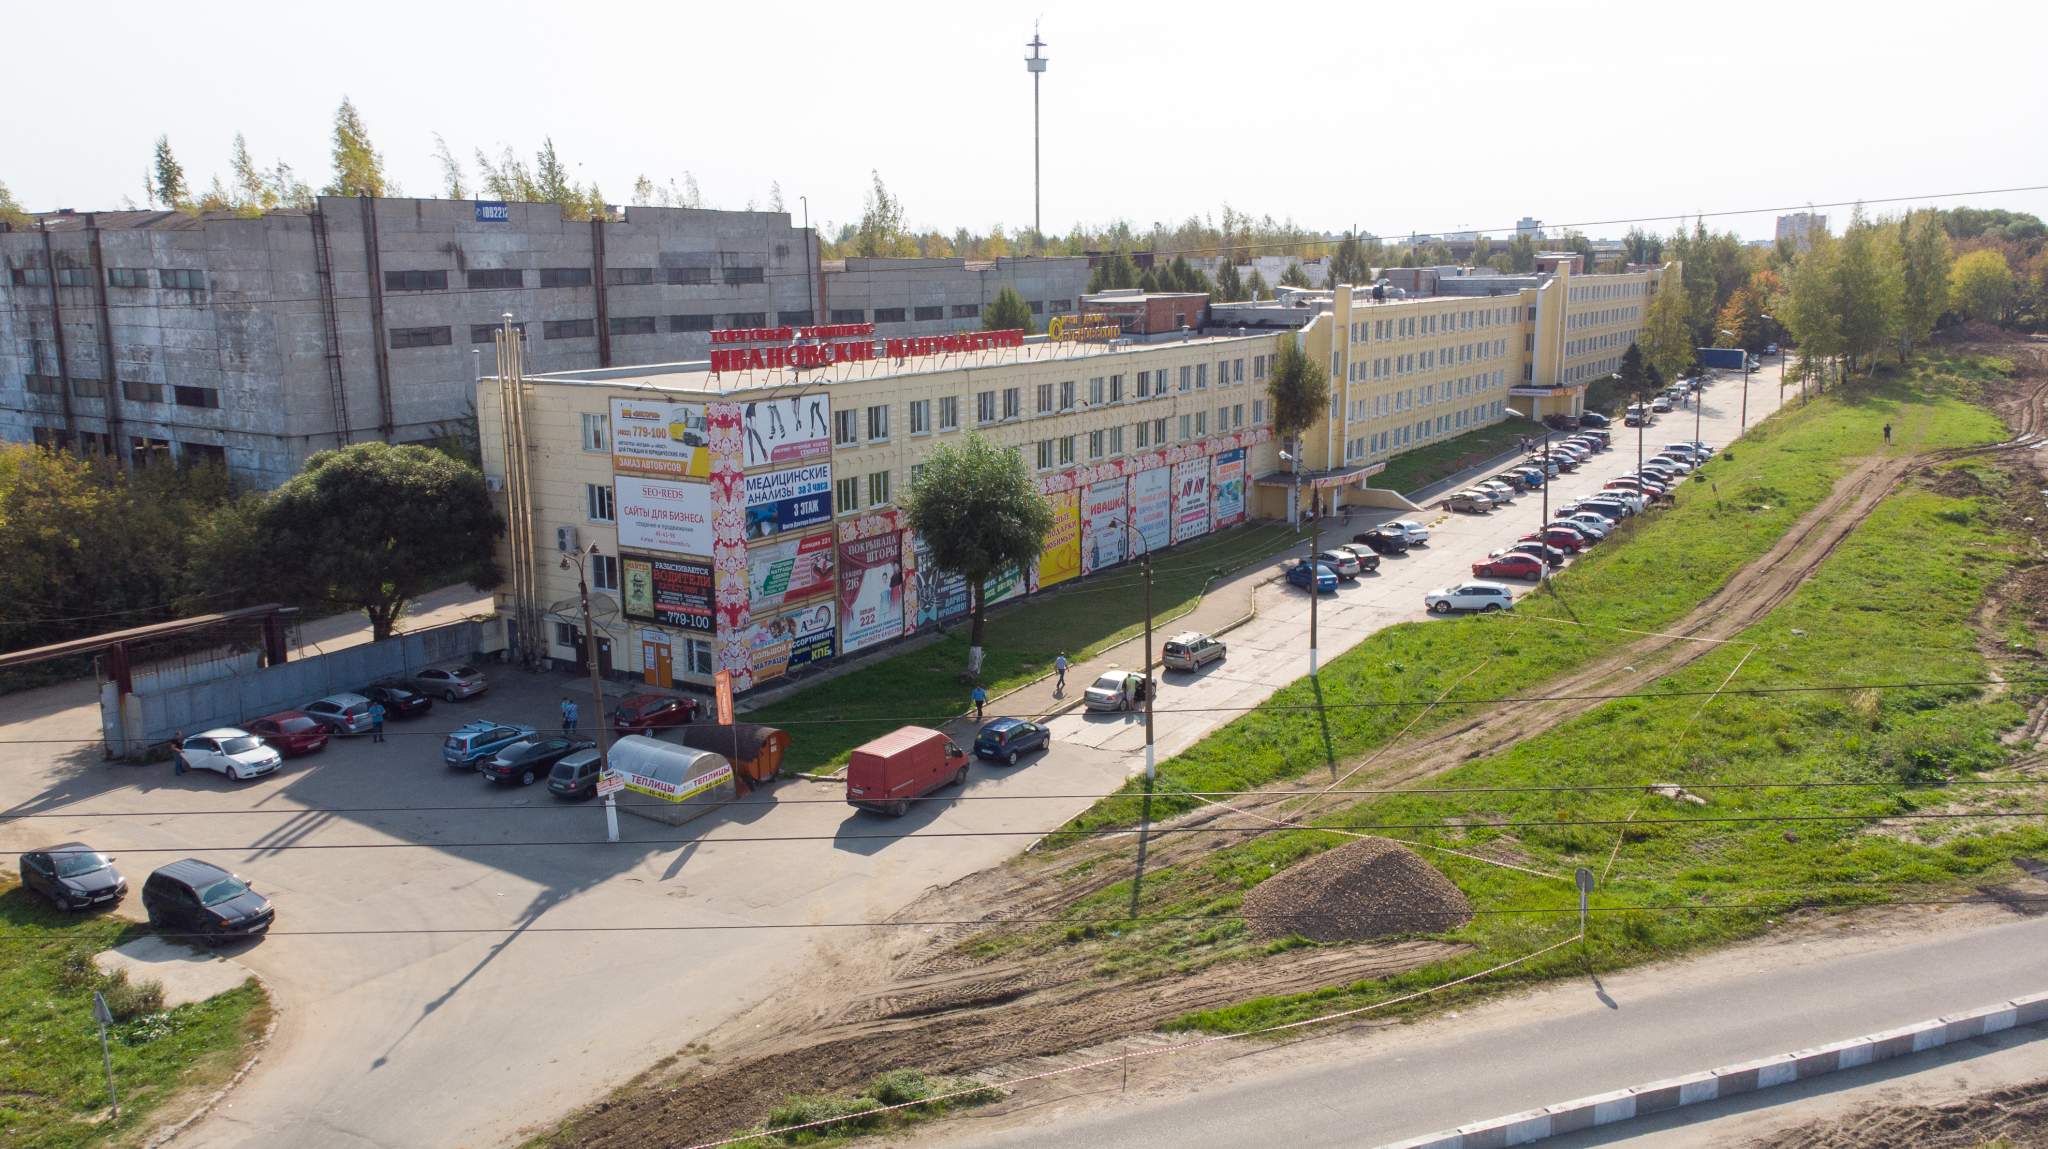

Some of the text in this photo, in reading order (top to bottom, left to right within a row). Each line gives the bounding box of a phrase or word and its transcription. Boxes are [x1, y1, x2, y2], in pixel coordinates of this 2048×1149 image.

[632, 426, 667, 439] 779-100
[618, 458, 681, 472] ЗАКАЗ АВТОБУСОВ
[746, 466, 828, 491] МЕДИЦИНСКИЕ
[748, 482, 828, 504] АНАЛИЗЫ за 3 часа
[794, 500, 819, 517] 3 ЭТАЖ
[1091, 496, 1126, 515] ИВАШКА
[624, 506, 704, 524] САЙТЫ ДЛЯ БИЗНЕСА
[1047, 520, 1077, 539] ПОДАРКИ
[848, 536, 896, 555] ПОКРЫВАЛА
[866, 545, 898, 562] ШТОРЫ
[667, 611, 709, 629] 779-100
[860, 614, 876, 627] 222
[631, 775, 675, 793] ТЕПЛИЦЫ
[694, 766, 730, 786] ТЕПЛИЦЫ
